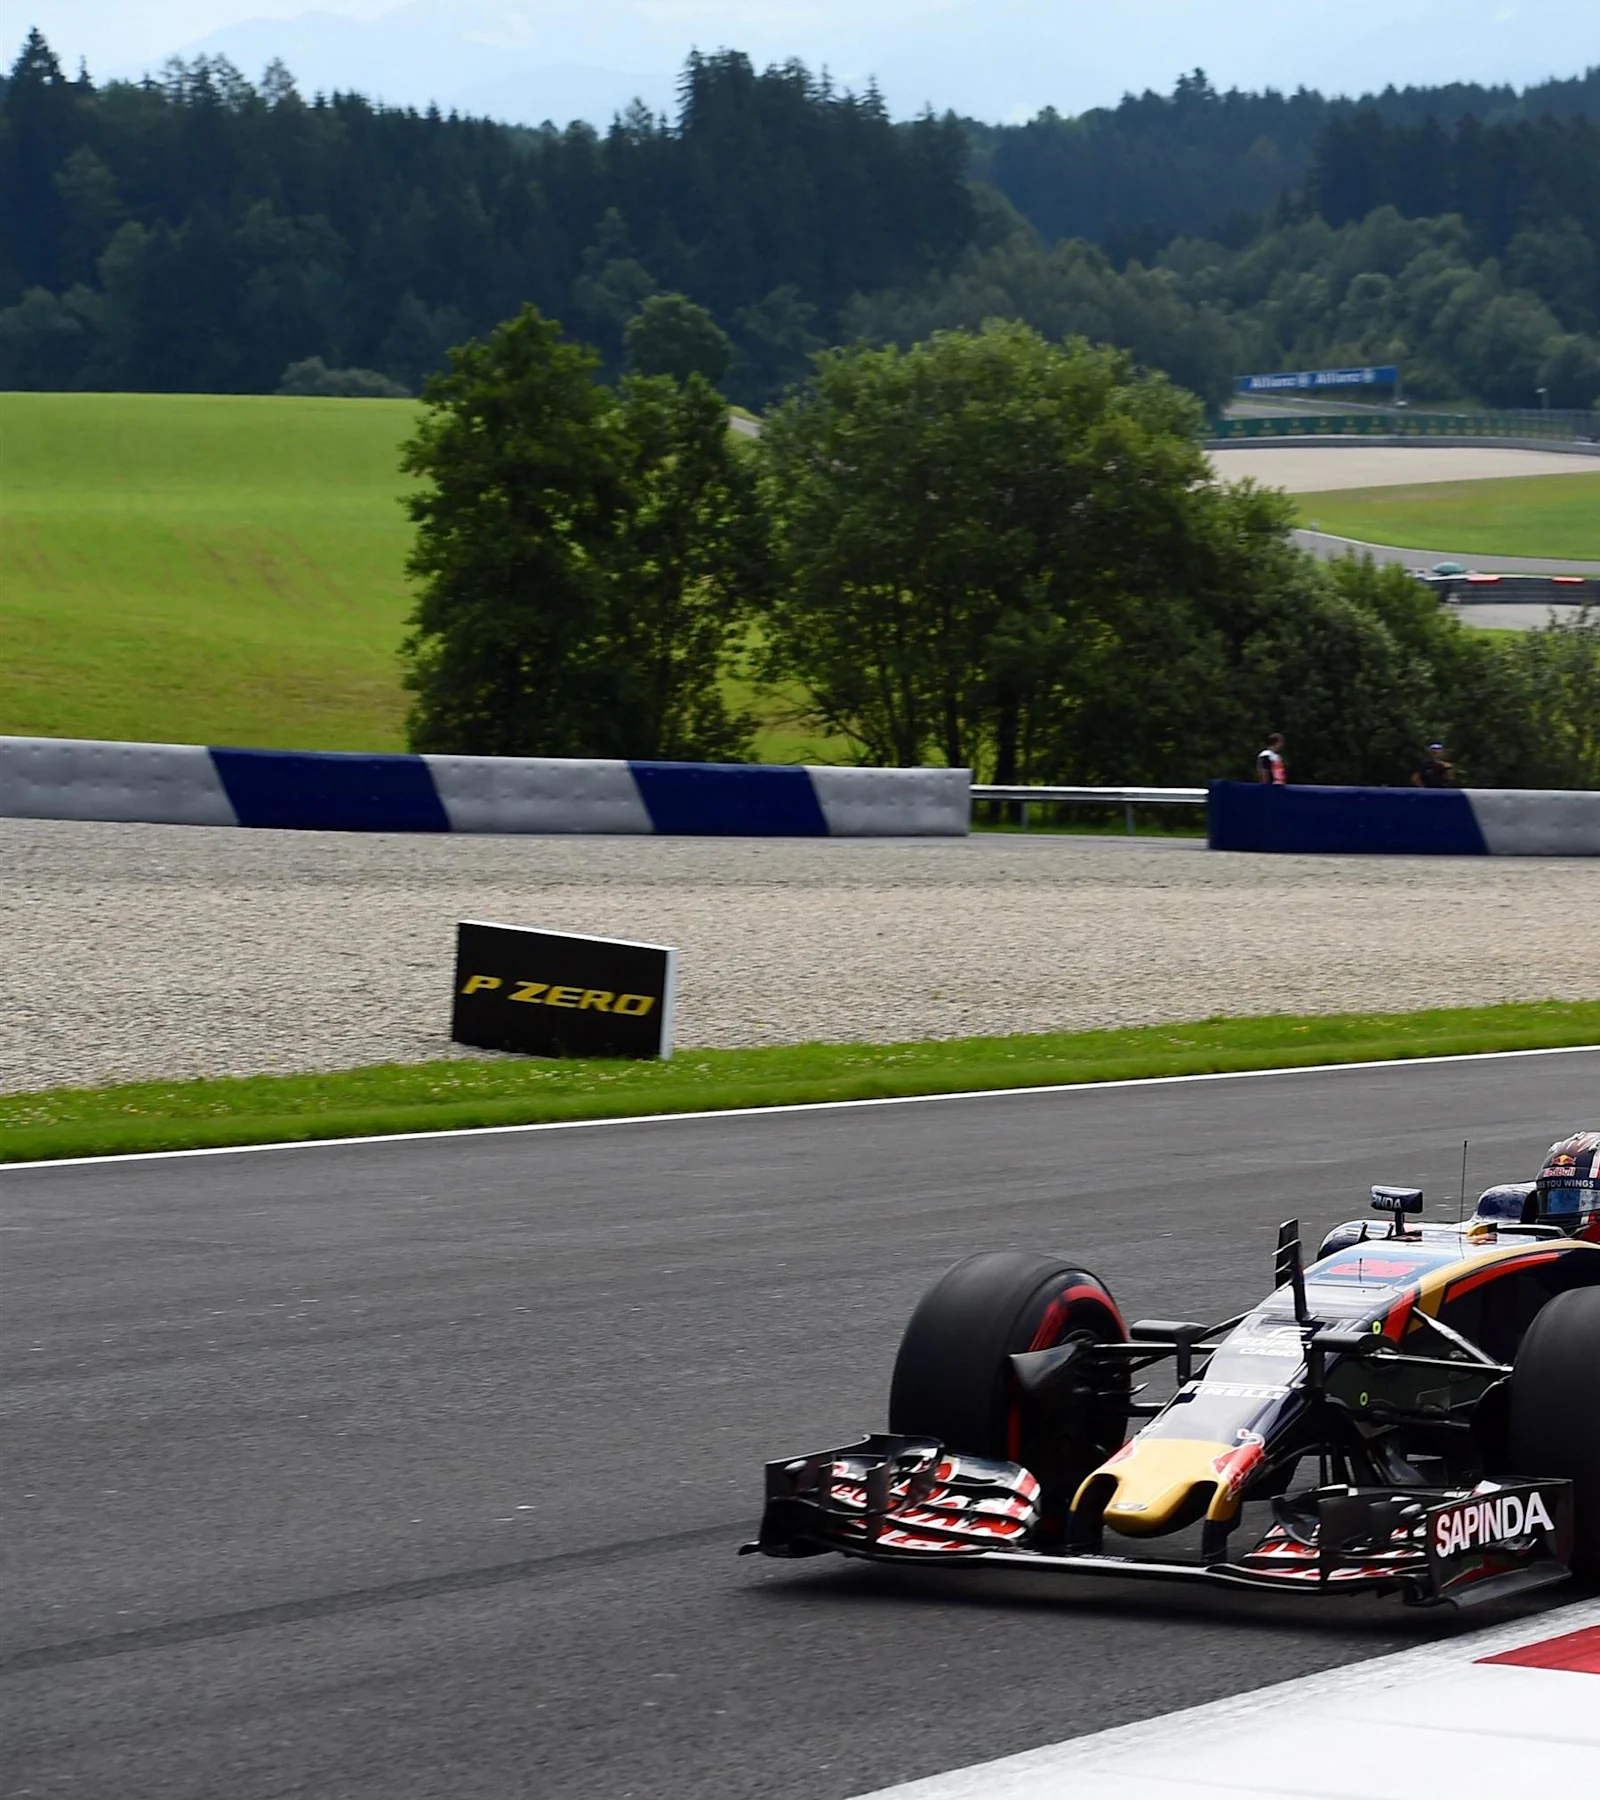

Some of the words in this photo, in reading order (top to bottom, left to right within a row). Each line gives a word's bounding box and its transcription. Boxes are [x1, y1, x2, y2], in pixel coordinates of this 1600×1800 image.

[461, 975, 503, 995] P
[507, 980, 656, 1016] ZERO
[1546, 1180, 1562, 1188] YOU
[1563, 1179, 1594, 1189] WINGS
[1436, 1492, 1555, 1558] SAPINDA
